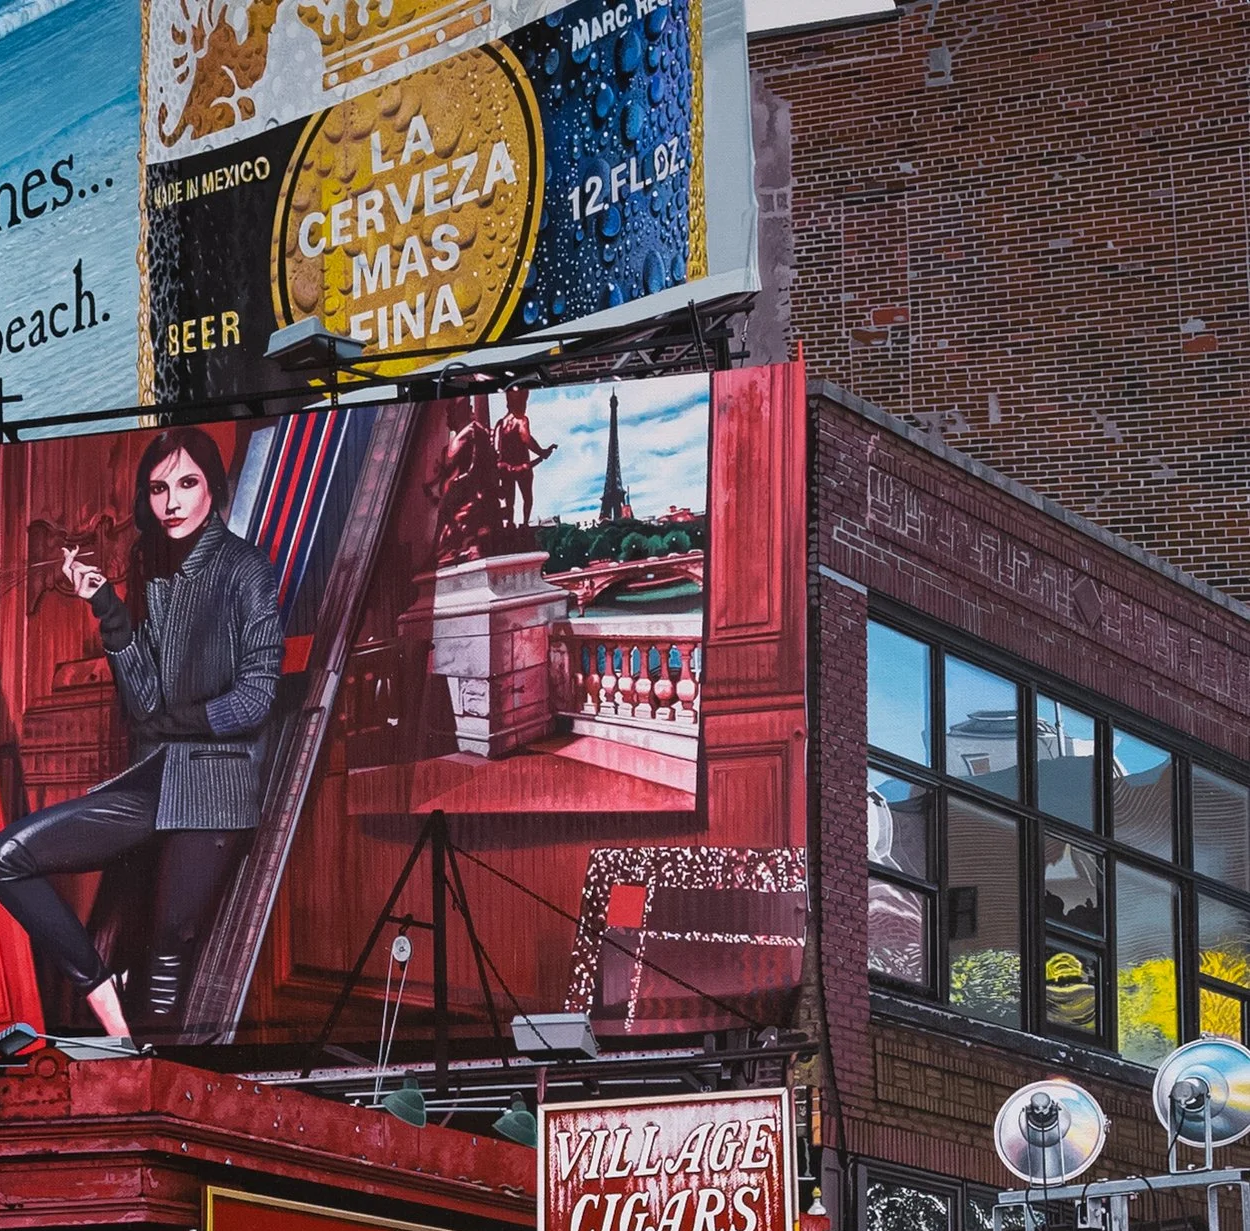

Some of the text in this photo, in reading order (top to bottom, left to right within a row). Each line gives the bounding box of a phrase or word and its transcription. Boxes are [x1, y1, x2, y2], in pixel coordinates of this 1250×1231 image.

[572, 3, 632, 52] MARC.
[369, 114, 434, 175] LA
[186, 176, 199, 201] IN
[202, 156, 270, 195] MEXICO
[299, 142, 519, 259] CERVEZA
[352, 225, 461, 300] MAS
[168, 310, 240, 357] BEER
[350, 286, 465, 352] FINA
[556, 1117, 776, 1181] VILLAGE
